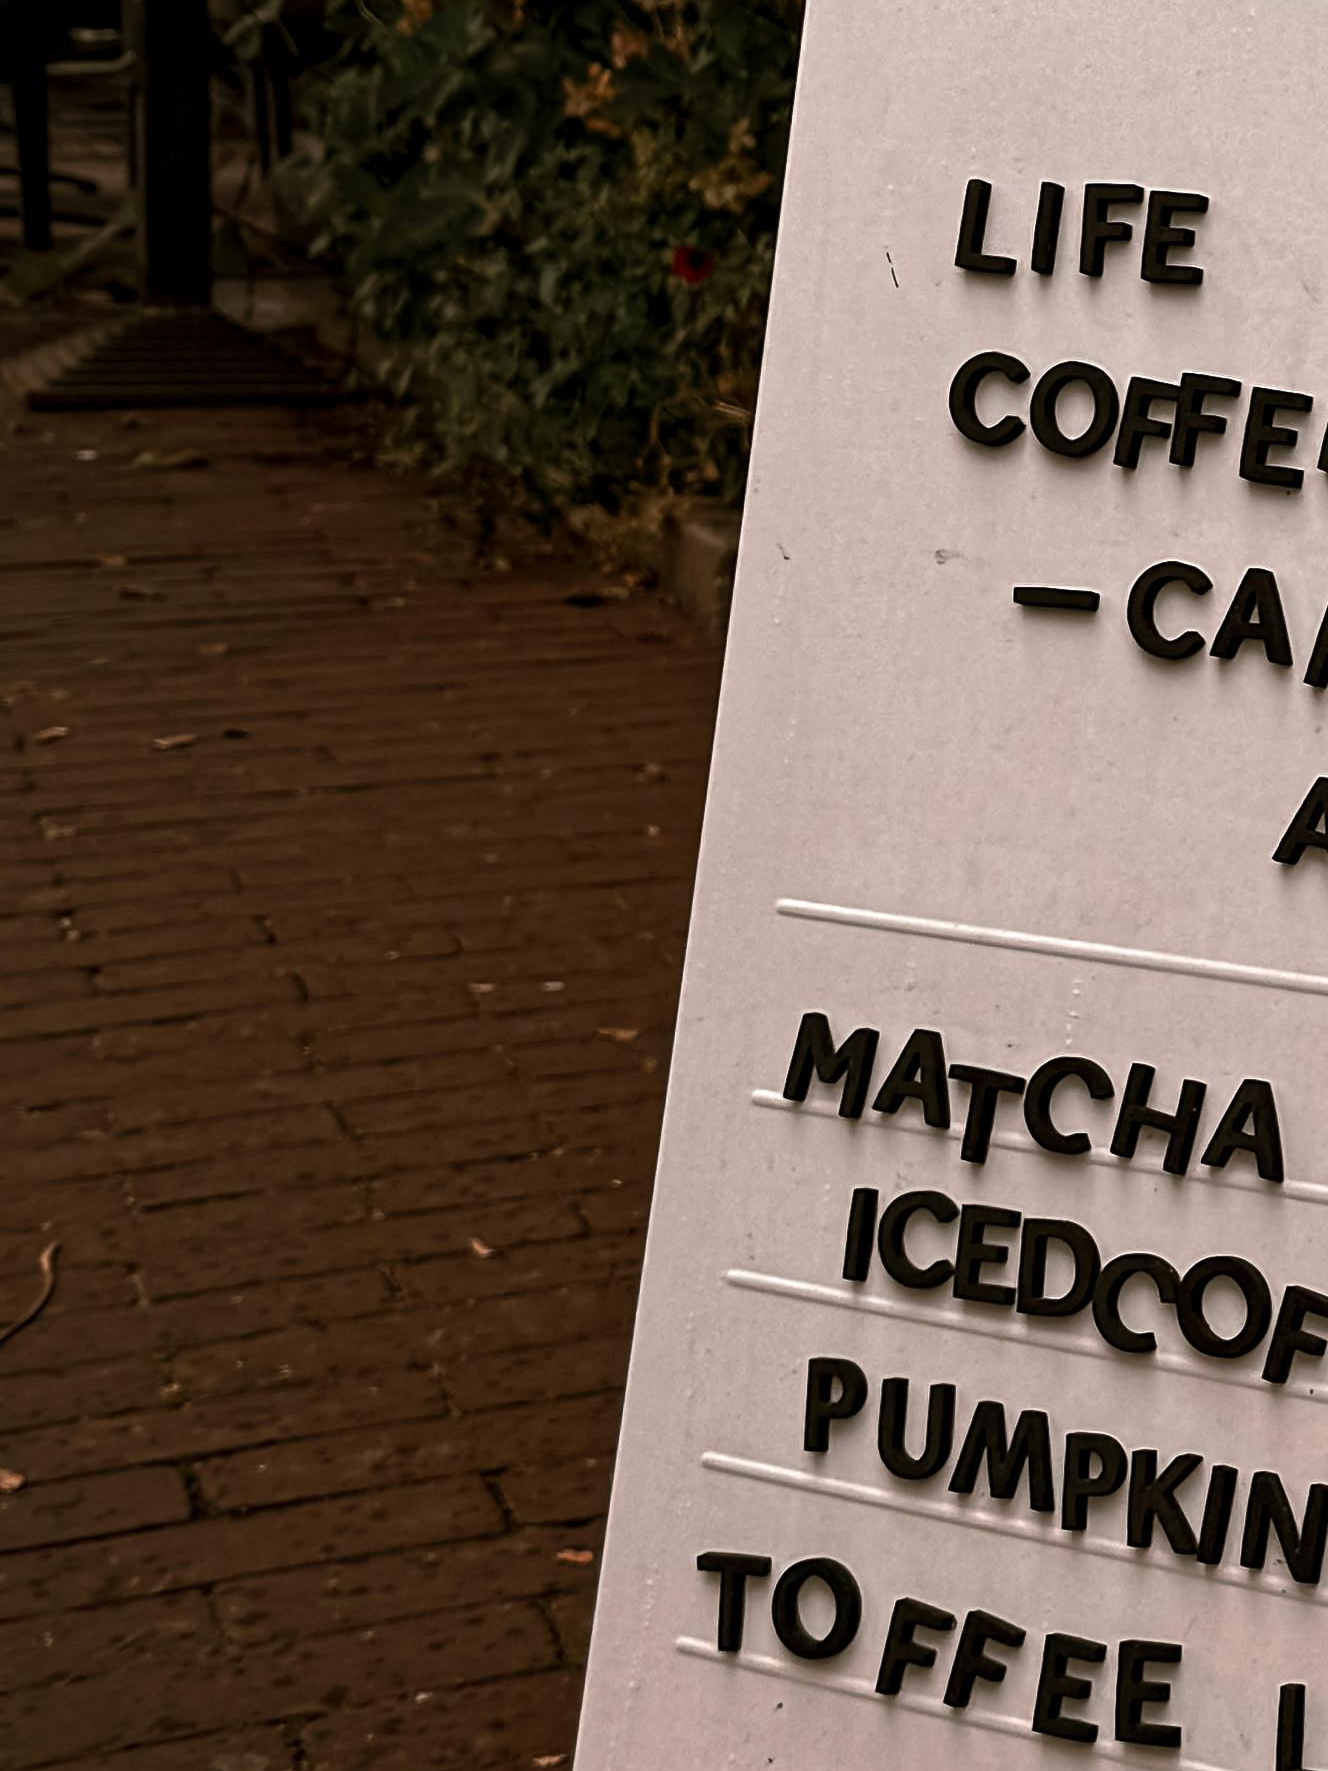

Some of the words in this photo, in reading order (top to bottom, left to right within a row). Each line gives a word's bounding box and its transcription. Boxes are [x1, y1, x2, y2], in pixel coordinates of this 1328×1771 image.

[955, 179, 1209, 289] LIFE
[783, 1013, 1283, 1184] MATCHA
[697, 1552, 1181, 1750] TOFFEE
